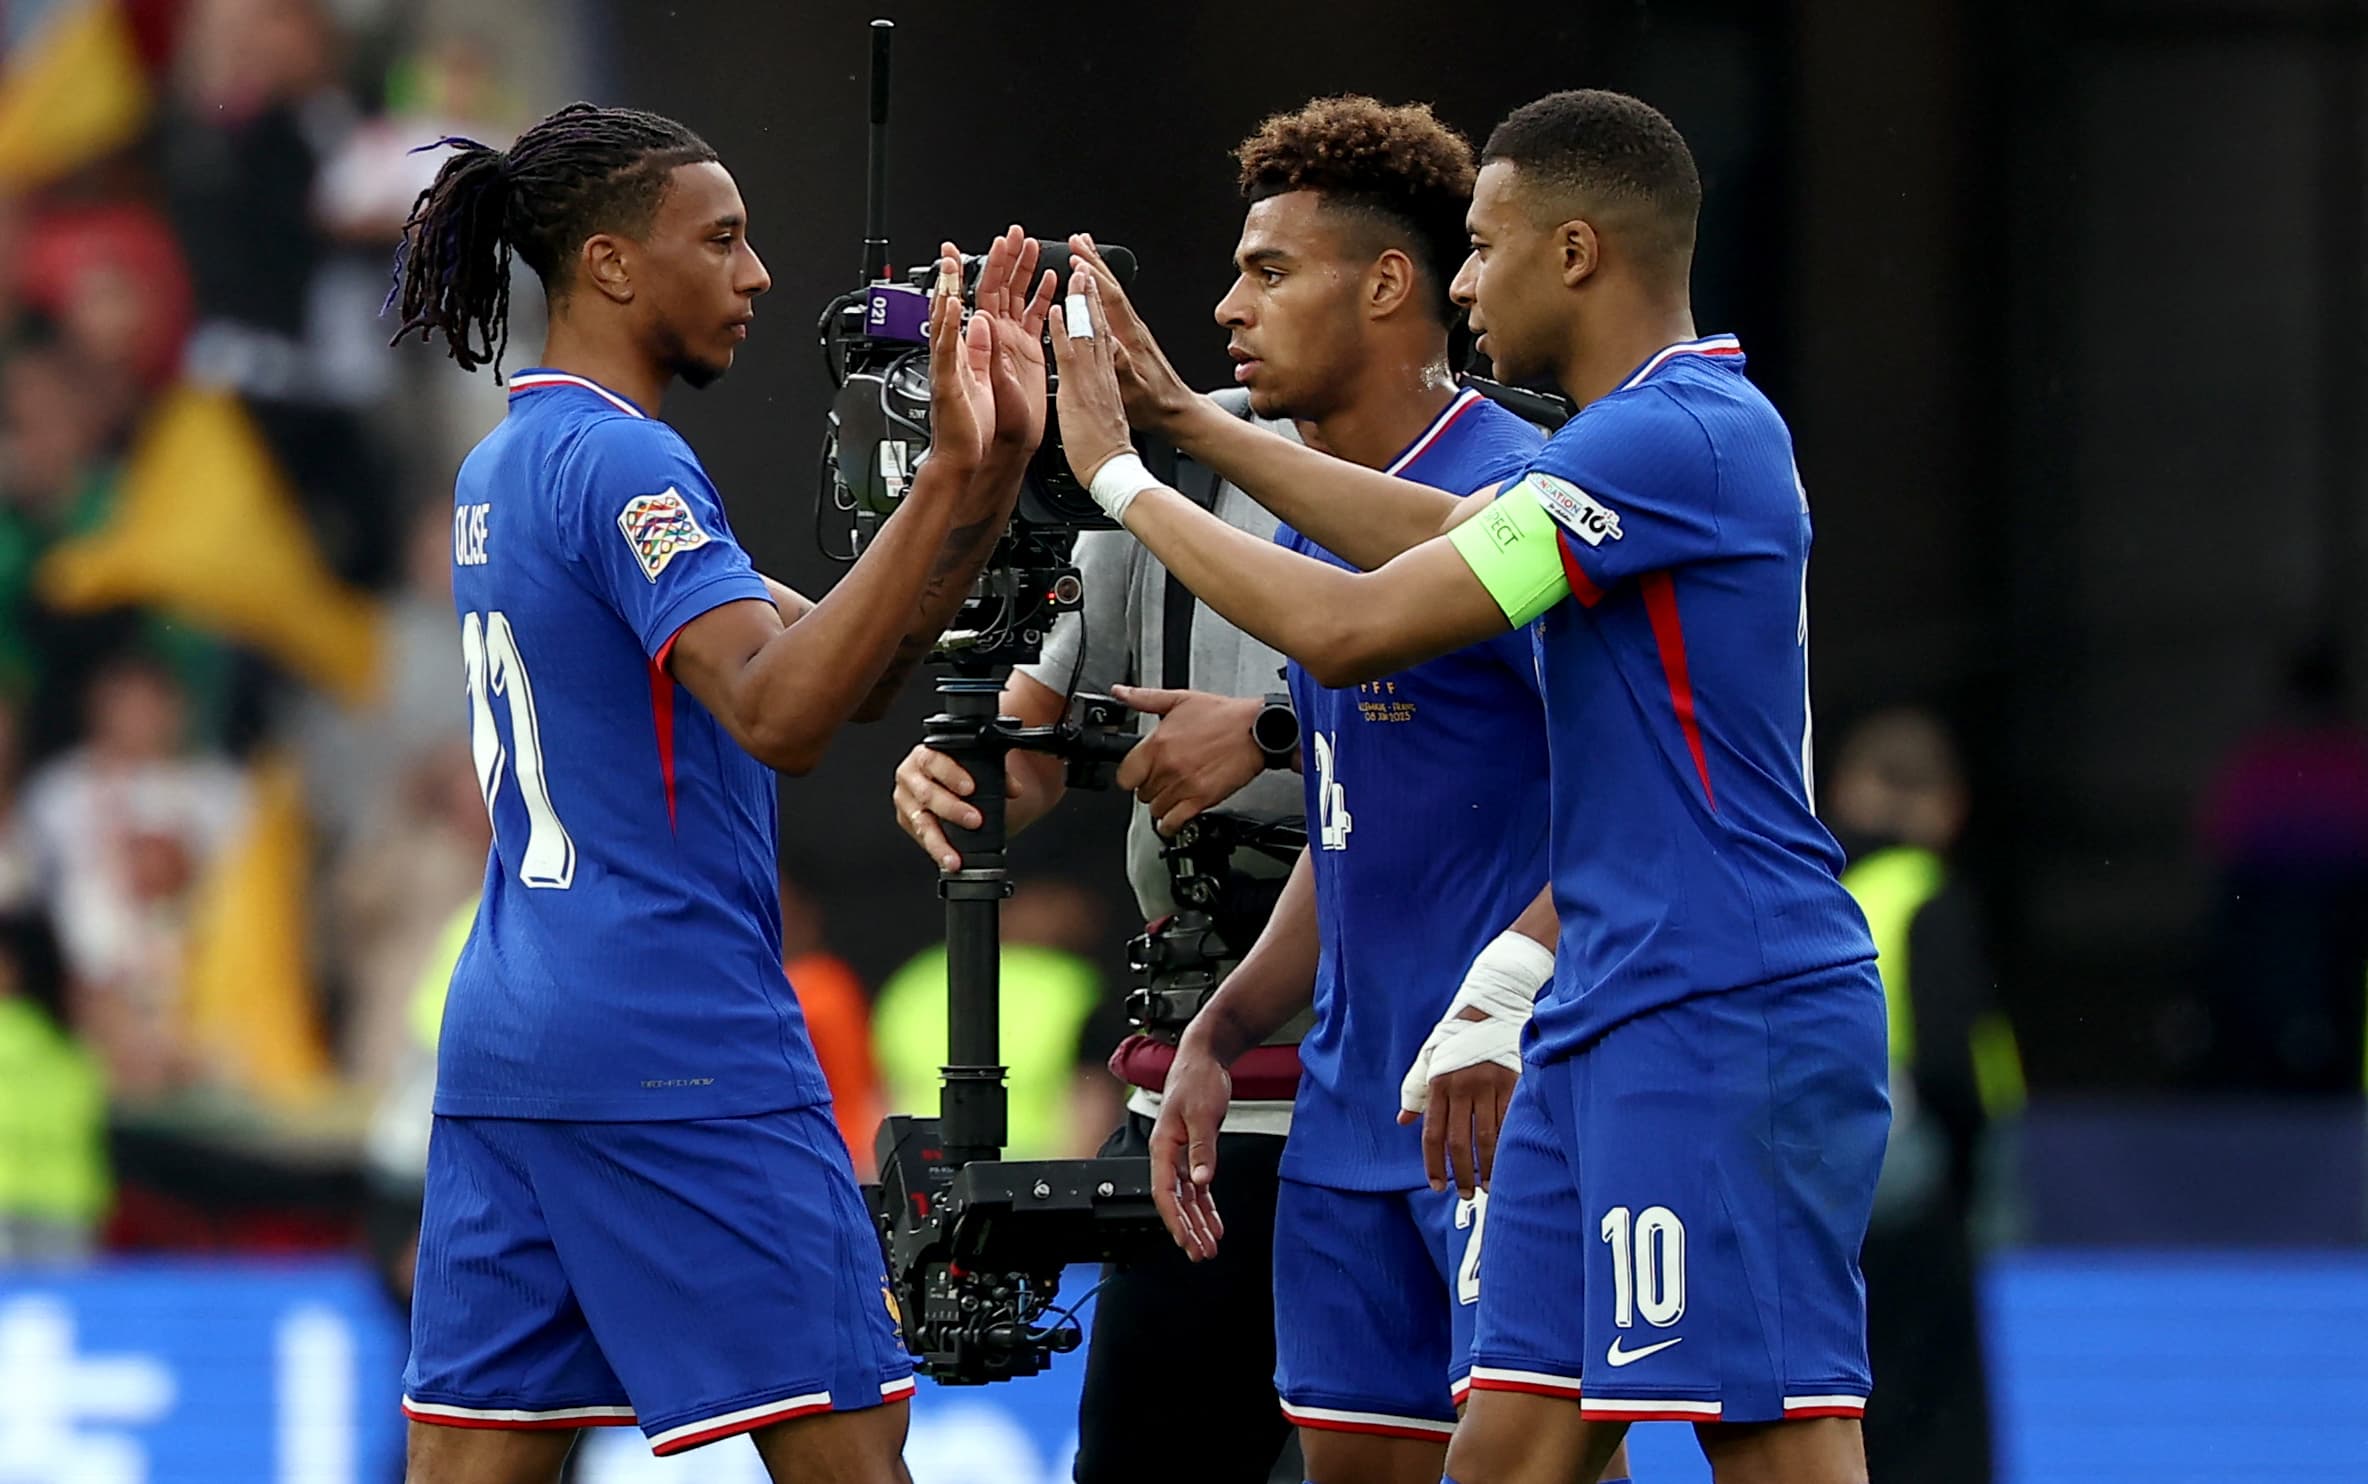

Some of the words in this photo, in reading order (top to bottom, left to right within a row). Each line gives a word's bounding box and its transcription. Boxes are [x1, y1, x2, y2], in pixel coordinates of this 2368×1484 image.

[871, 297, 887, 325] 021
[455, 503, 490, 566] OLISE
[1580, 506, 1607, 534] 10
[461, 611, 577, 890] 11
[1455, 1186, 1489, 1306] 2
[1601, 1205, 1687, 1328] 10
